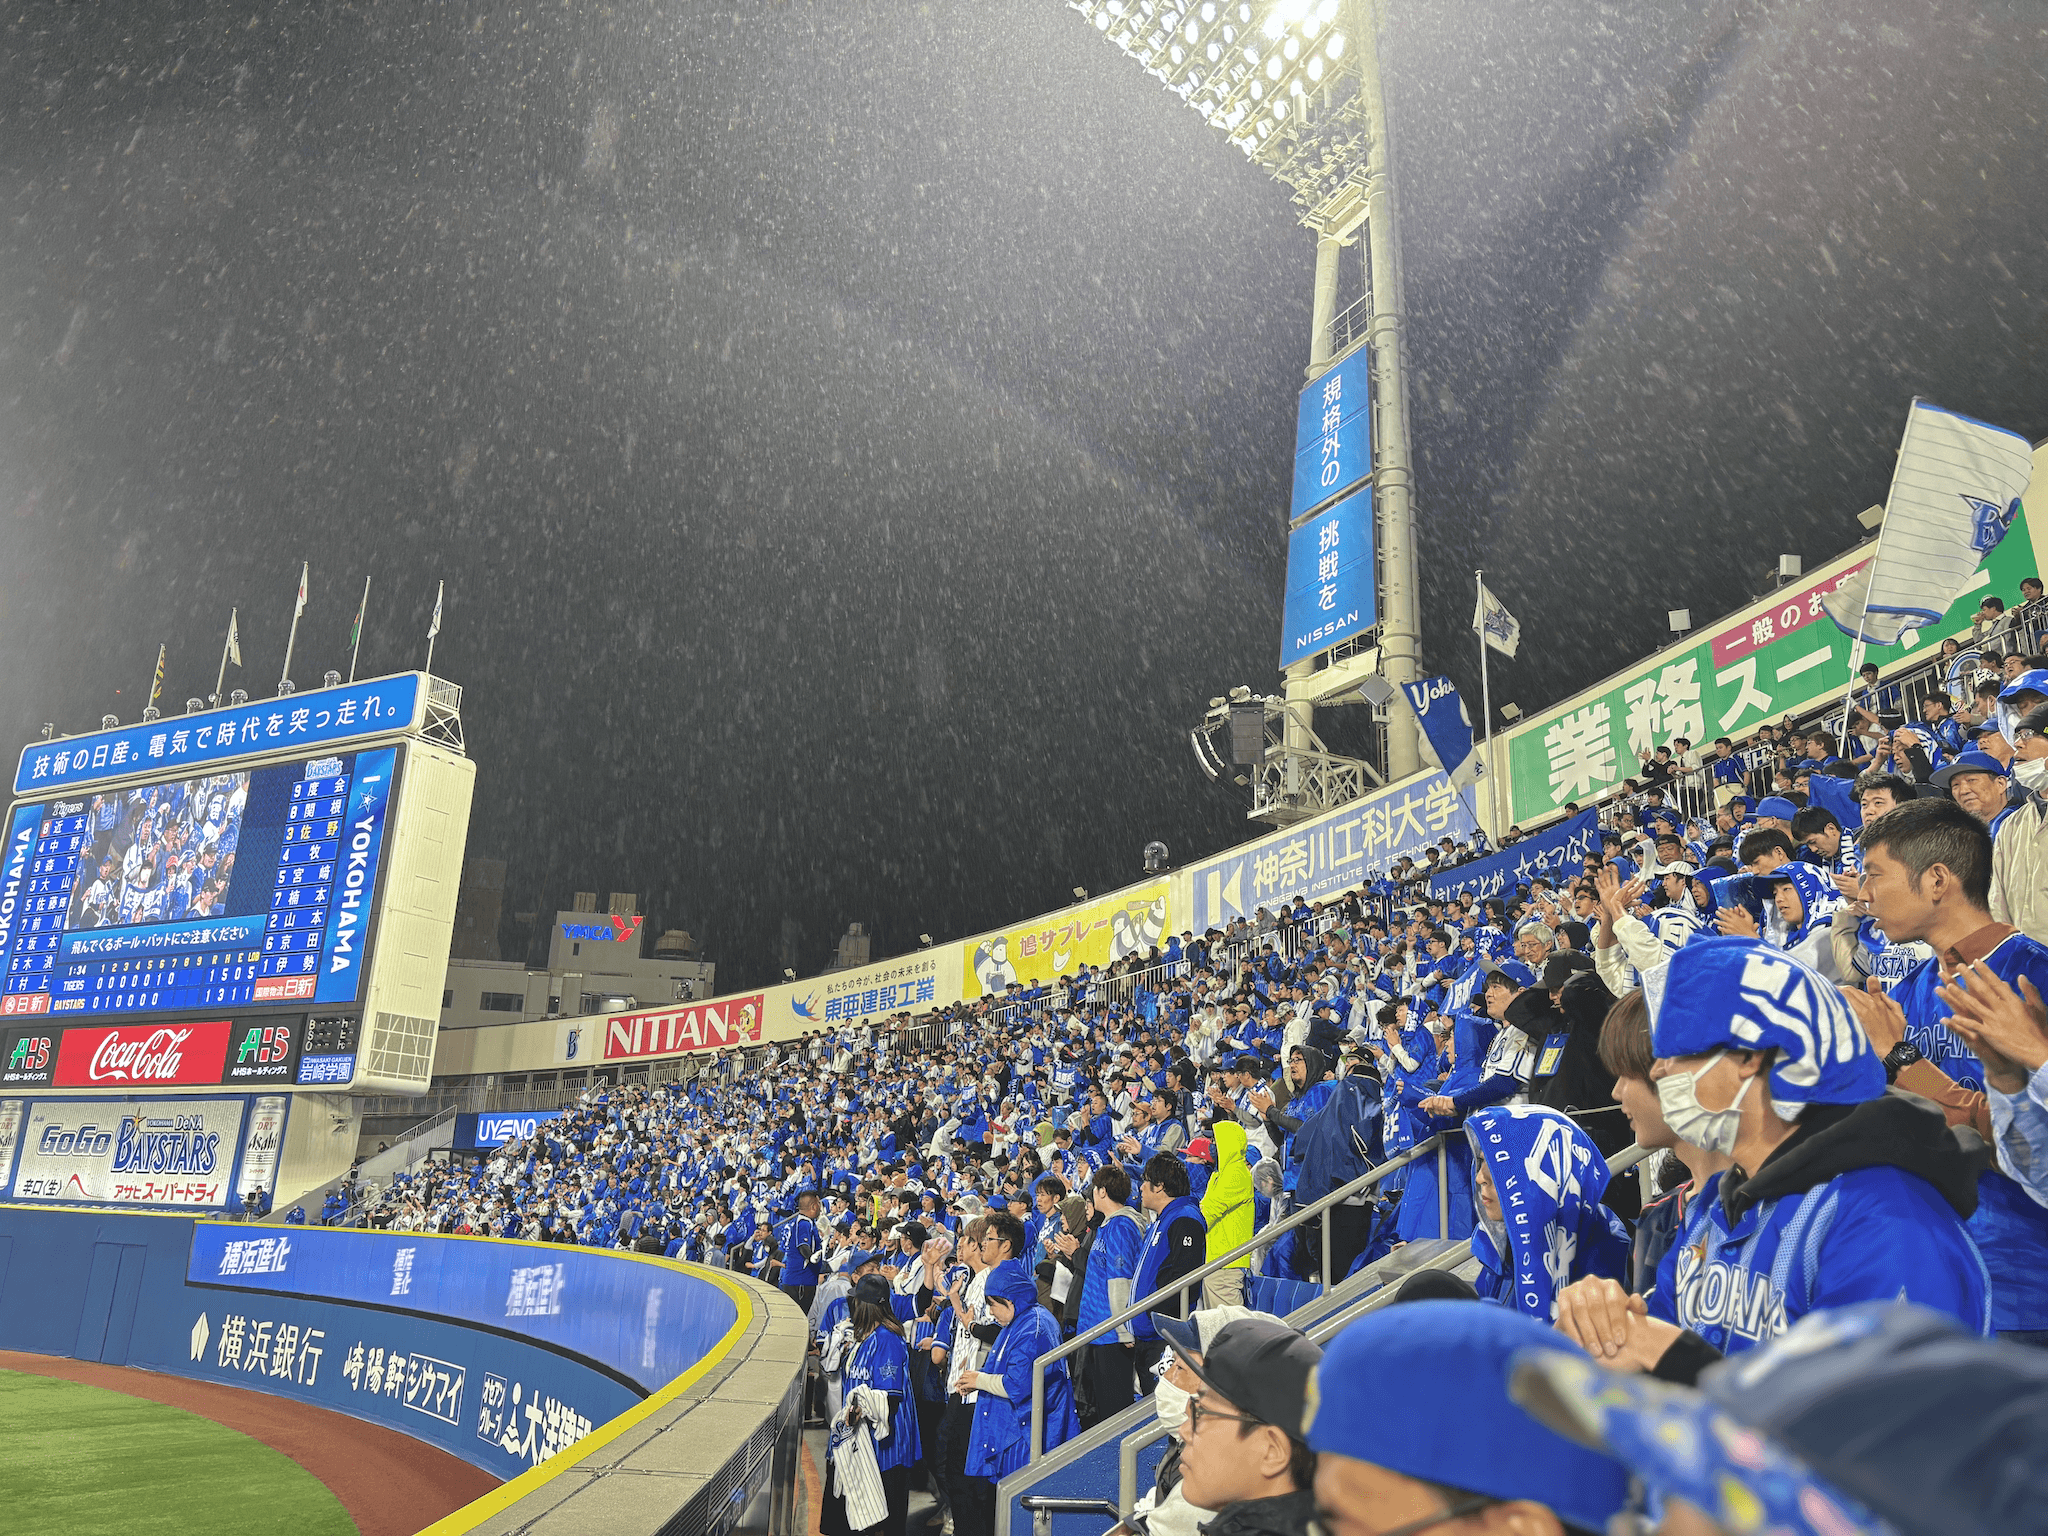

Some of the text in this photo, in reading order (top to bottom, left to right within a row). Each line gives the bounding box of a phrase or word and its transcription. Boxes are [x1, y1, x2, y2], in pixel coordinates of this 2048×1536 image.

[1321, 374, 1342, 487] 規格外の
[1318, 519, 1339, 611] 挑戦を
[1296, 610, 1358, 649] NISSAN
[32, 695, 396, 779] 技術の日産。電気で時代を突っ走れ。
[294, 785, 302, 798] 9
[52, 801, 84, 816] Tigers
[43, 817, 84, 835] 8 近本
[286, 821, 338, 841] 3 佐野
[38, 836, 81, 853] 4 中野
[1253, 779, 1459, 898] 神奈川工科大学
[282, 844, 321, 861] 4 牧
[34, 856, 76, 873] 9 森下
[30, 876, 70, 892] 3 大山
[278, 870, 286, 884] 5
[1311, 869, 1363, 891] INSTITUTE
[1366, 861, 1381, 876] OF
[0, 828, 33, 955] OKOHAMA
[275, 892, 281, 906] 7
[330, 815, 374, 973] YOKOHAMA
[25, 899, 32, 912] 5
[21, 914, 61, 931] 7 前川
[270, 909, 323, 928] 2 山本
[71, 926, 249, 954] 飛んでくるボール・バットにご注意ください
[265, 931, 319, 950] 6 京田
[561, 923, 613, 941] YMCA
[1019, 919, 1109, 959] 鳩サブレー
[16, 938, 23, 951] 2
[12, 957, 18, 970] 6
[68, 965, 86, 976] 1:34
[101, 963, 105, 973] 1
[111, 963, 117, 973] 2
[123, 962, 129, 971] 3
[135, 961, 140, 970] 4
[147, 960, 153, 969] 5
[159, 959, 165, 969] 6
[172, 958, 177, 968] 7
[197, 956, 202, 966] 9
[212, 955, 218, 964] R
[224, 954, 231, 963] H
[237, 953, 243, 963] E
[262, 955, 314, 973] 1 伊勢
[8, 974, 48, 991] 1 村上
[63, 966, 255, 991] TIGERS 0 0 0 0 0 1 0 1 5 0 5
[827, 959, 937, 994] 私たちの今が、社会の未来を創る
[54, 986, 250, 1010] BAYSTARS 0 1 0 0 0 0 1 3 1 1
[825, 975, 935, 1022] 東亜建設工業
[308, 1019, 316, 1030] B
[607, 1004, 730, 1056] NITTAN
[237, 1026, 290, 1063] AHS
[307, 1030, 314, 1041] S
[8, 1037, 51, 1069] AHS
[300, 1062, 351, 1081] 岩崎学園
[175, 1115, 203, 1131] DeNA
[479, 1118, 536, 1141] UYENO
[111, 1115, 219, 1174] BAYSTARS
[248, 1131, 278, 1151] Asahi
[1182, 1236, 1193, 1247] 63
[1505, 1175, 1542, 1321] OKOHAMA
[218, 1237, 291, 1275] 横浜進化
[218, 1314, 325, 1386] 横浜銀行
[342, 1341, 407, 1400] 崎陽軒
[406, 1362, 462, 1418] シウマイ
